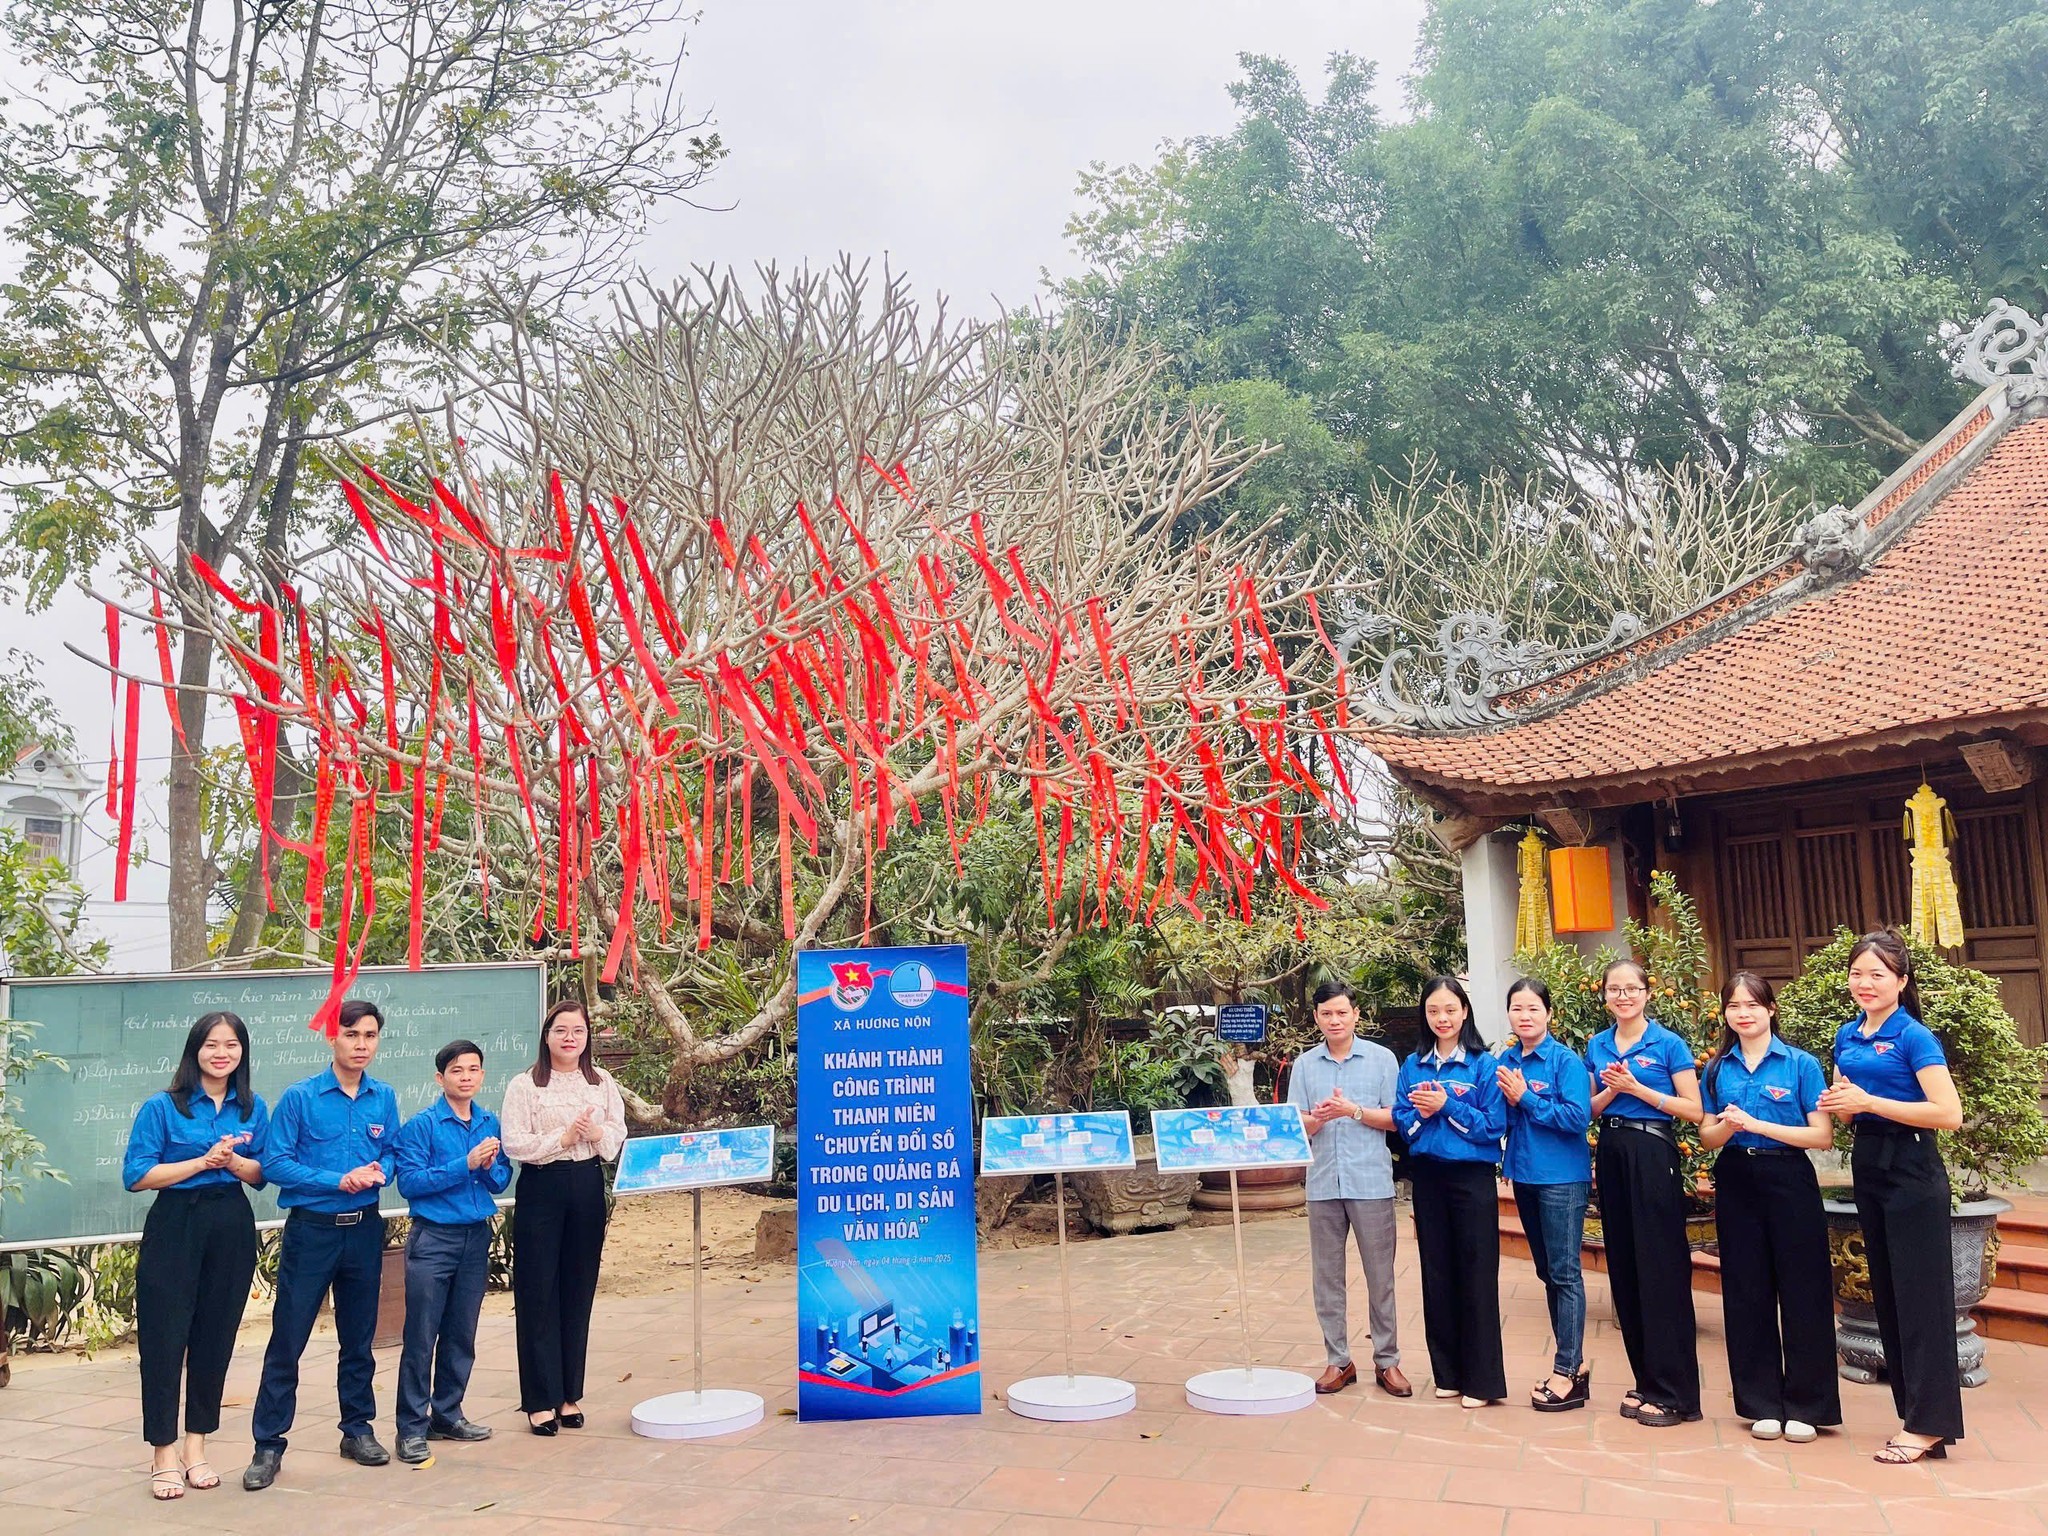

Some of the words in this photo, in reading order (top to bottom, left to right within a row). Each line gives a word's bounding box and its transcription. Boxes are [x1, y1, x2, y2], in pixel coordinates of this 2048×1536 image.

[833, 1018, 851, 1031] XÃ
[856, 1016, 900, 1030] HƯƠNG
[904, 1015, 931, 1029] NỘN
[824, 1048, 882, 1070] KHÁNH
[887, 1046, 943, 1067] THÀNH
[832, 1076, 880, 1098] CÔNG
[885, 1074, 935, 1095] TRÌNH
[832, 1106, 889, 1126] THANH
[894, 1102, 936, 1123] NIÊN
[814, 1128, 893, 1155] “CHUYỂN
[897, 1127, 926, 1152] ĐỔI
[931, 1126, 955, 1150] SỐ
[810, 1165, 867, 1184] TRONG
[872, 1158, 932, 1183] QUẢNG
[936, 1157, 961, 1179] BÁ
[817, 1195, 841, 1213] DU
[846, 1193, 890, 1215] LỊCH,
[895, 1192, 913, 1210] DI
[918, 1185, 954, 1209] SẢN
[843, 1220, 879, 1242] VĂN
[884, 1215, 929, 1240] HÓA”
[935, 1253, 952, 1263] 2025
